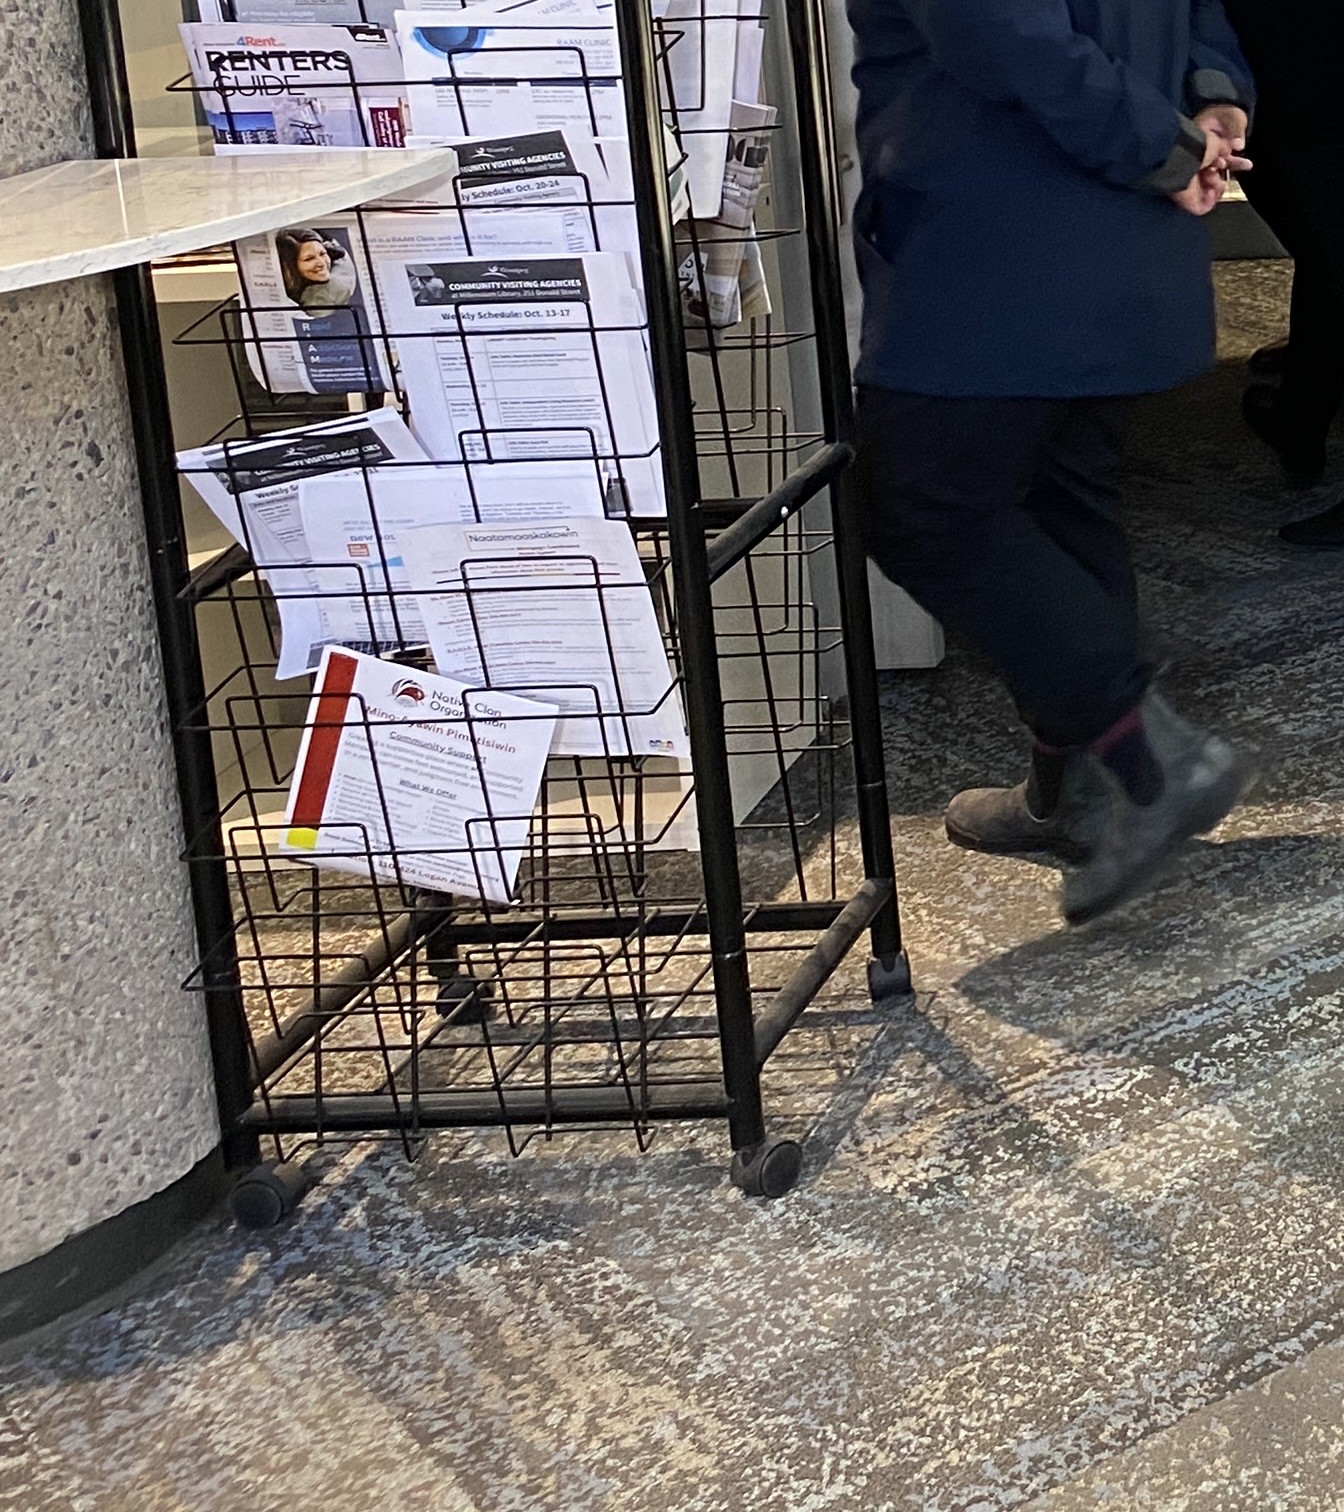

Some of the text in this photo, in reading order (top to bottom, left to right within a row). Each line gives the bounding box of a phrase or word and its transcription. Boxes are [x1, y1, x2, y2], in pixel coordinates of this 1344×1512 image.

[583, 39, 612, 47] CLINIC
[205, 50, 350, 72] RENTERS
[213, 75, 306, 97] GUIDE
[491, 156, 526, 169] VISITING
[527, 152, 566, 164] AGENCIES
[472, 188, 514, 200] Schedule:
[516, 184, 534, 193] Oct.
[535, 180, 560, 190] 20-24
[449, 279, 582, 291] COMMUNITY VISITING AGENCIES
[441, 309, 571, 321] Wekly Schedule: Oct. 13-17
[304, 452, 341, 464] VISITING
[340, 444, 381, 457] AGECIES
[255, 487, 289, 499] Weekly
[474, 702, 502, 718] Clan
[390, 731, 487, 764] Community Suppt
[447, 728, 516, 754] Pimtisiwin
[399, 779, 457, 800] What We Offer
[449, 876, 480, 889] Avenu
